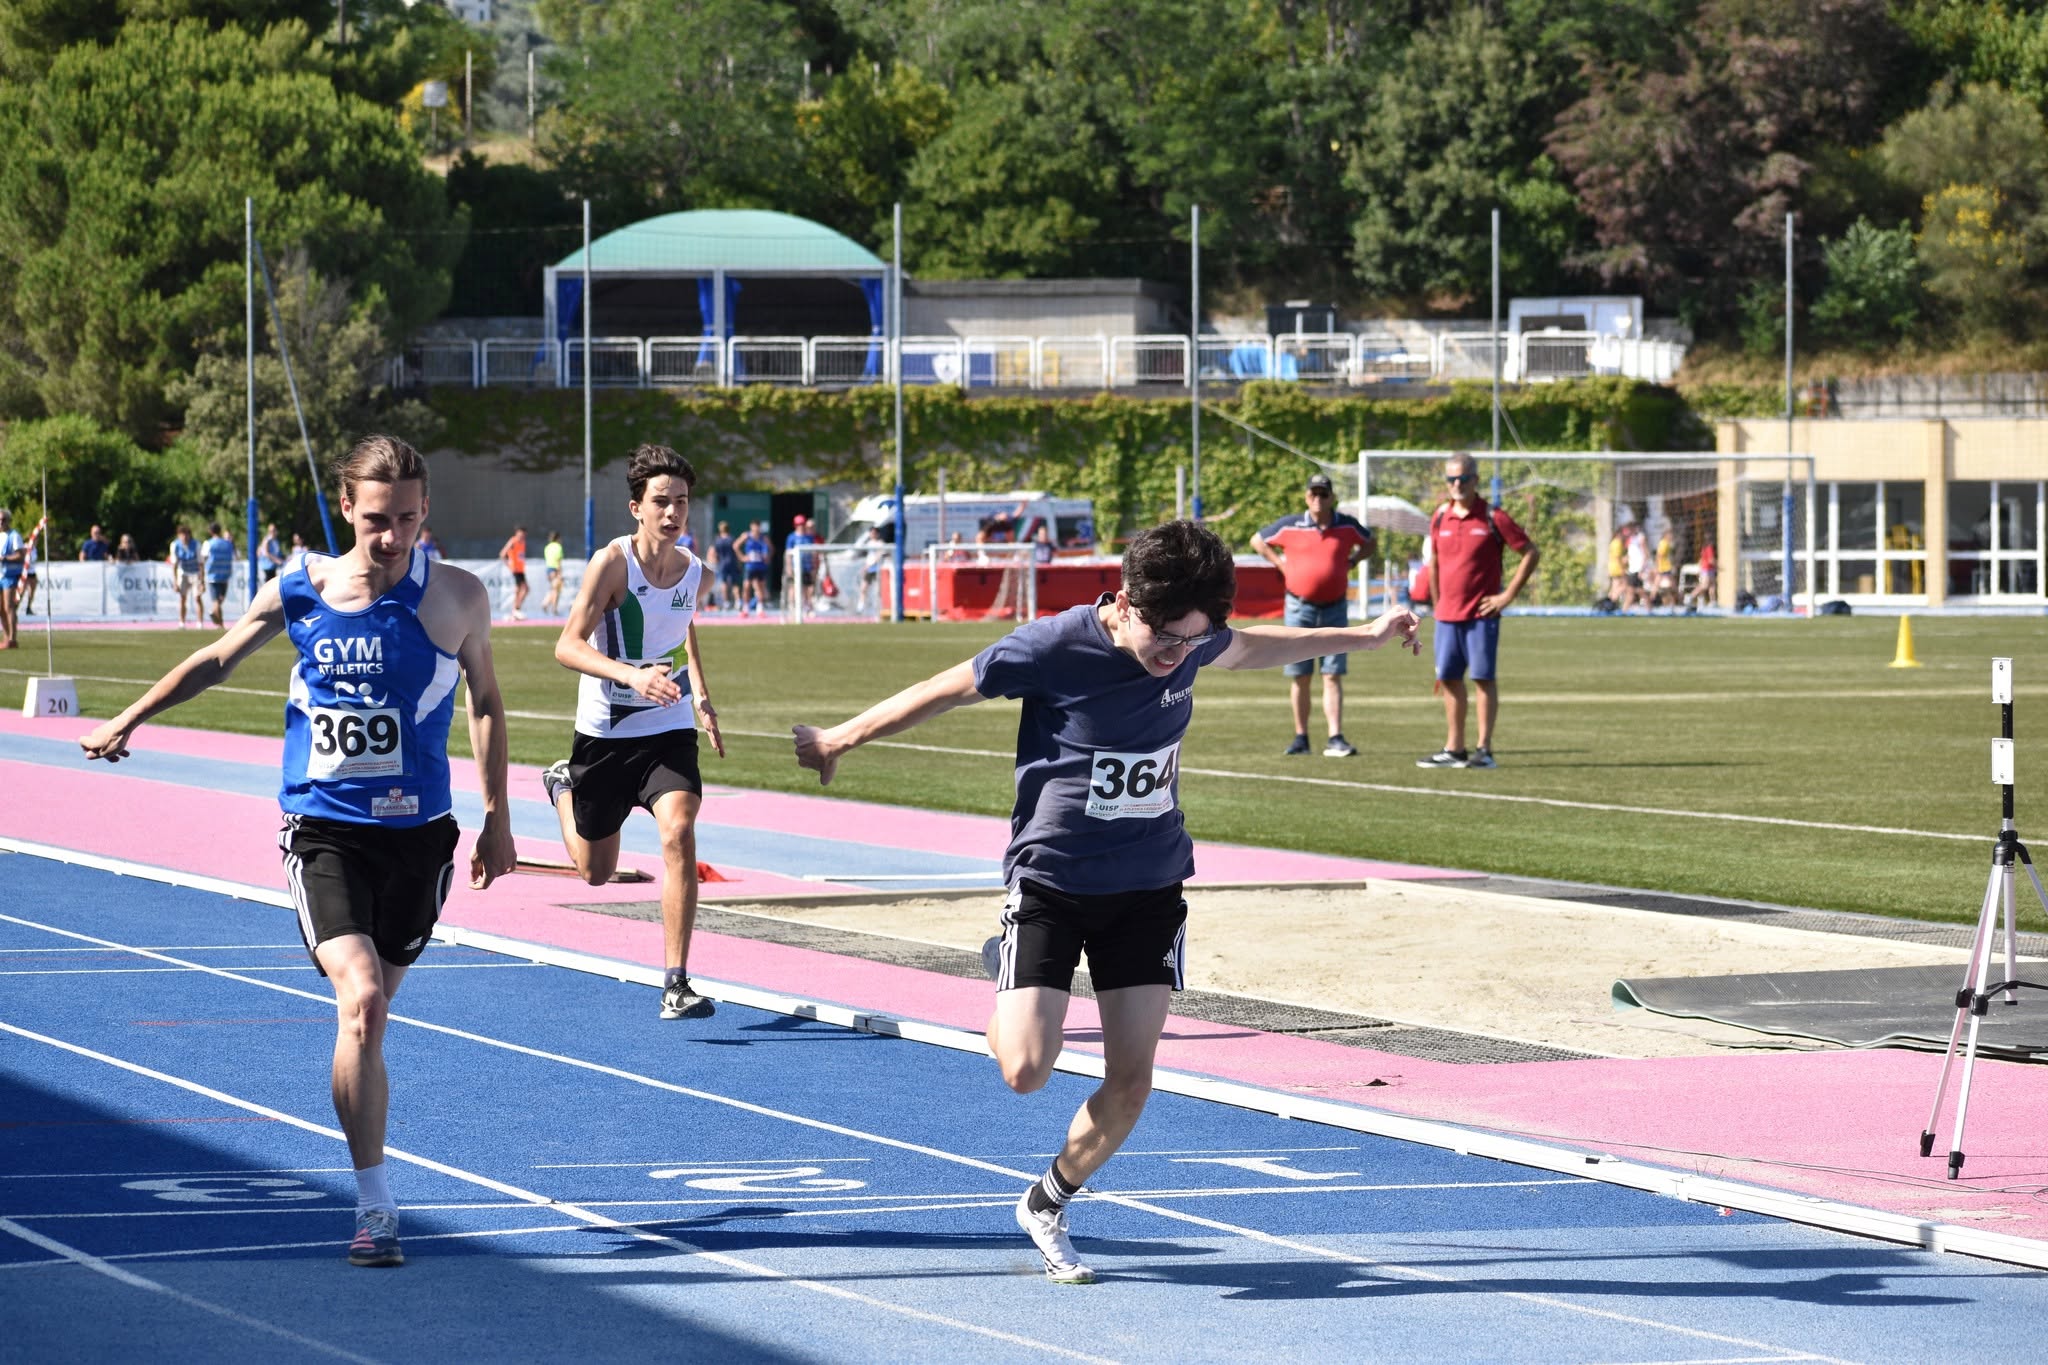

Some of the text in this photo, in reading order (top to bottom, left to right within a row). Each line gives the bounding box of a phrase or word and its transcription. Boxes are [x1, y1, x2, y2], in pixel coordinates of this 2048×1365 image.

[124, 577, 142, 591] DE
[314, 637, 383, 662] GYM
[319, 663, 384, 675] ATHLETICS
[47, 697, 68, 714] 20
[313, 714, 399, 756] 369
[1092, 749, 1177, 800] 364
[1098, 804, 1119, 812] UISP
[120, 1177, 326, 1202] 3
[649, 1166, 866, 1192] 2
